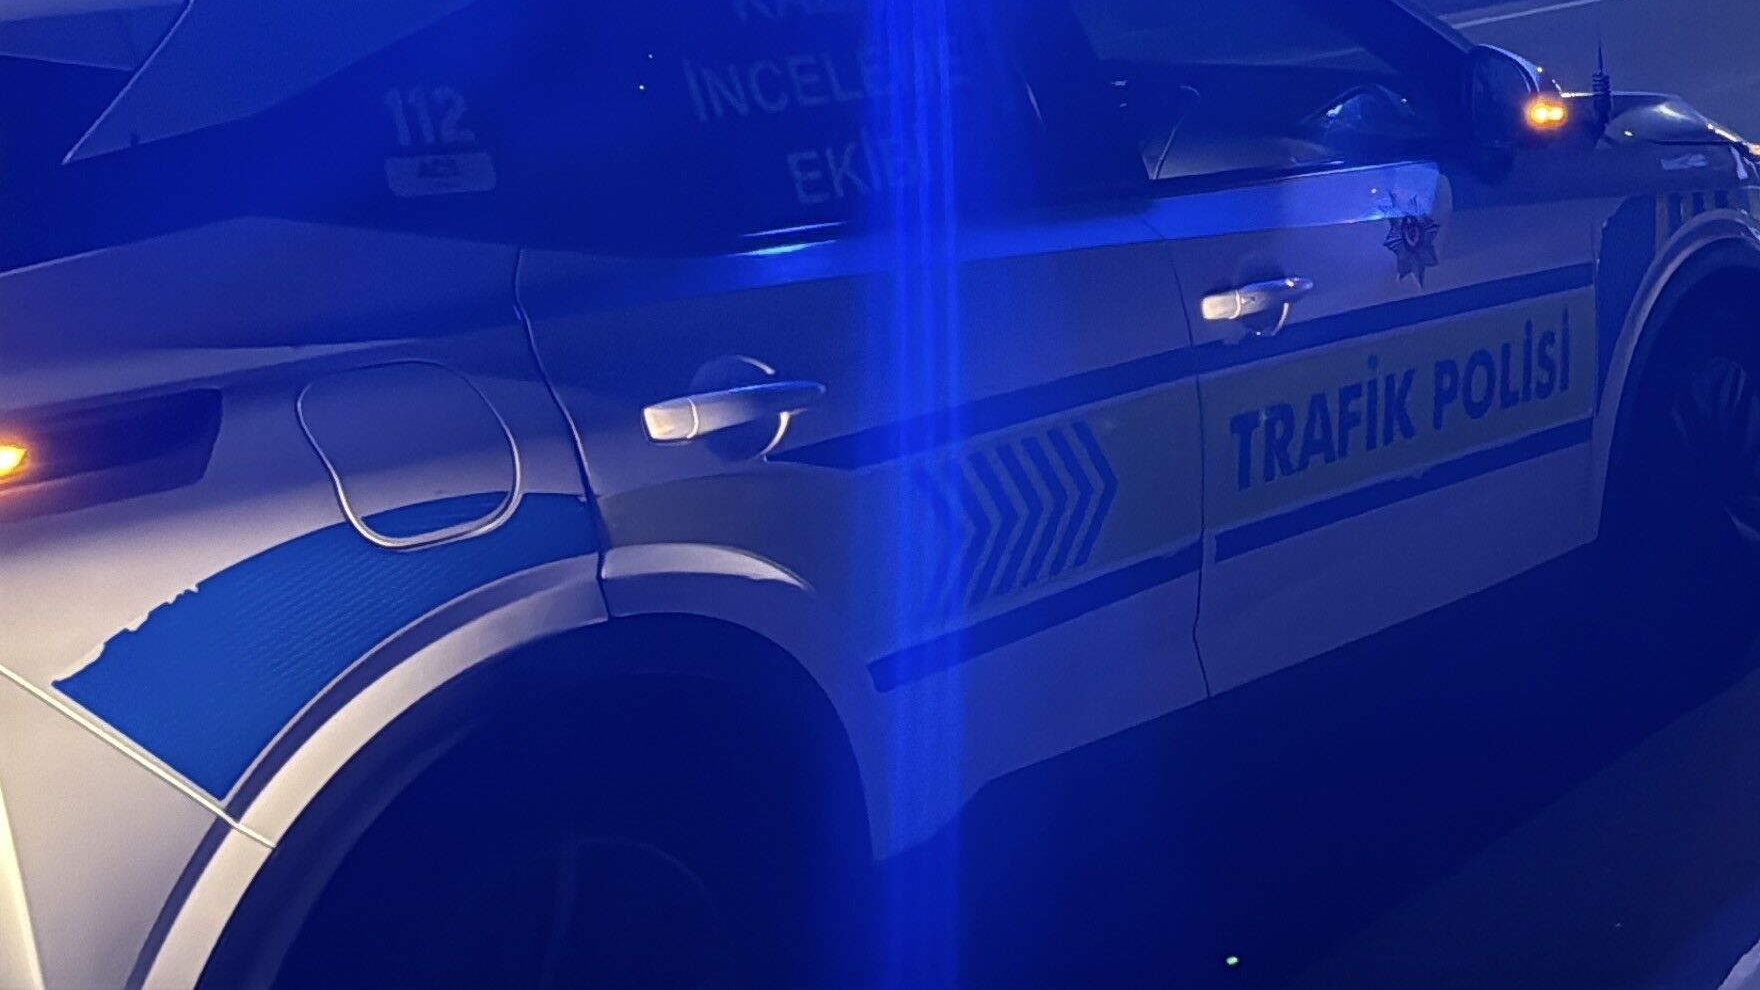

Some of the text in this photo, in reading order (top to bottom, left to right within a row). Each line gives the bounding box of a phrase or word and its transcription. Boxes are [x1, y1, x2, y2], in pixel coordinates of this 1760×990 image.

[383, 84, 476, 147] 112
[1229, 305, 1571, 491] TRAFİK POLİSİ
